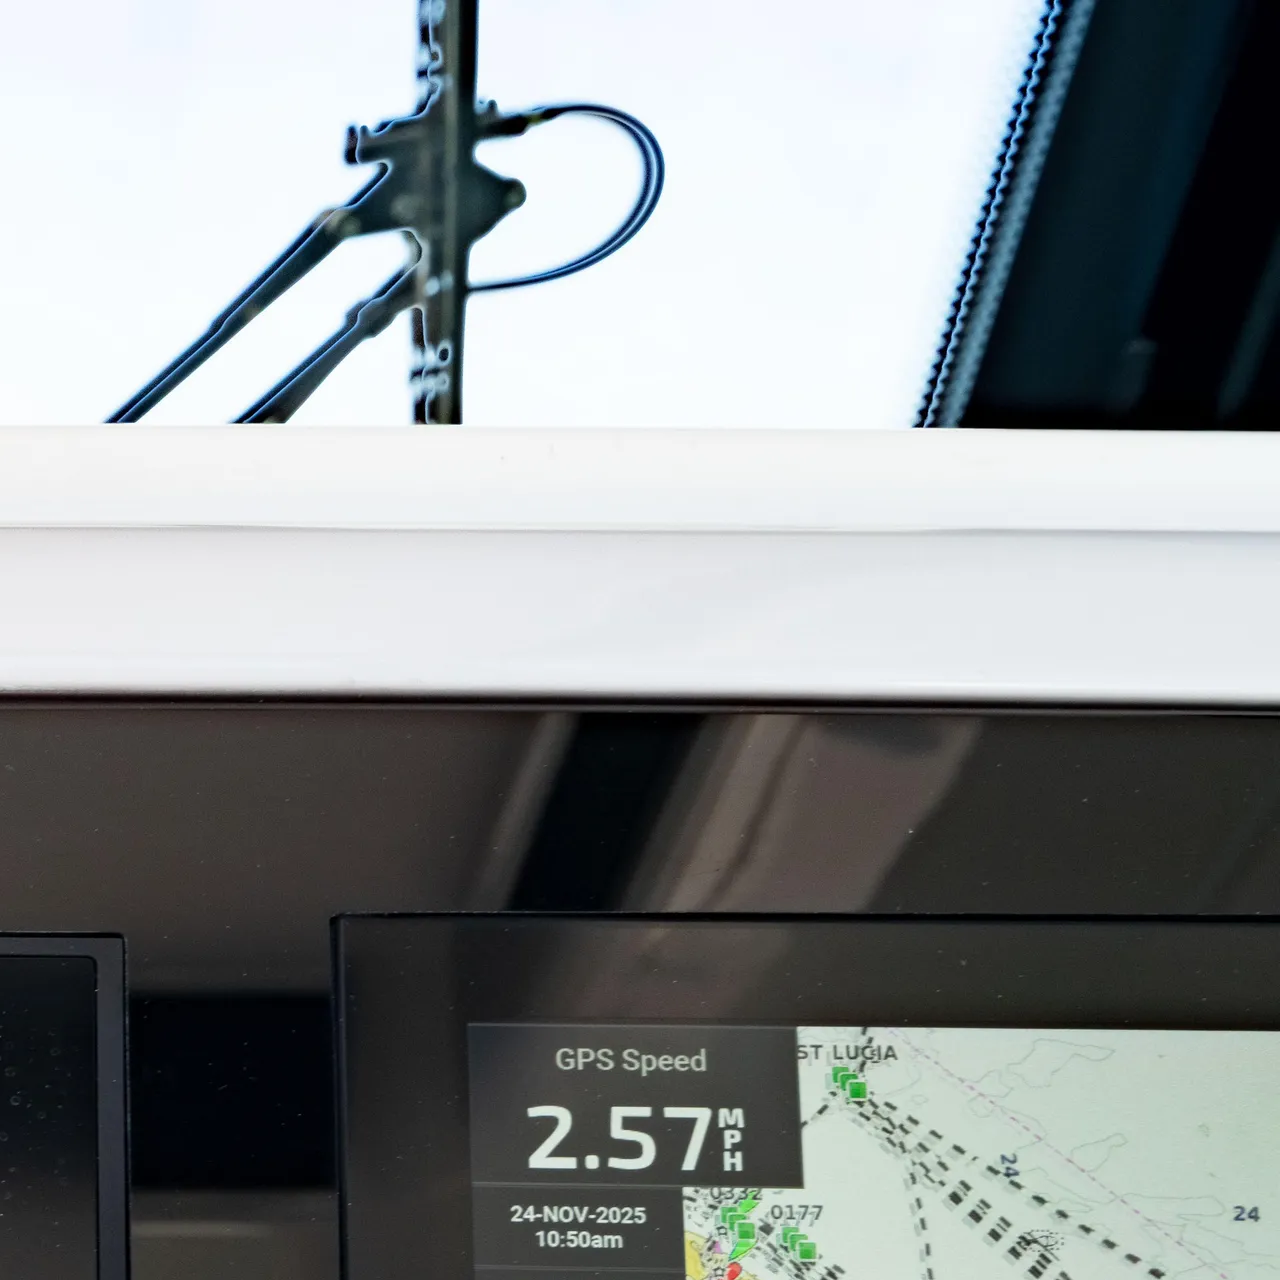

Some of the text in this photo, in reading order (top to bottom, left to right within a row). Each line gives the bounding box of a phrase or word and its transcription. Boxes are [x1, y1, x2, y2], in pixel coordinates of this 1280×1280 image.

[833, 1044, 898, 1061] LUCIA
[555, 1048, 707, 1077] GPS Speed
[527, 1105, 712, 1171] 2.57
[1000, 1153, 1019, 1179] 24
[510, 1205, 647, 1224] 24-NOV-2025
[771, 1205, 823, 1220] 0177
[1233, 1206, 1260, 1221] 24
[535, 1230, 623, 1249] 10:50am
